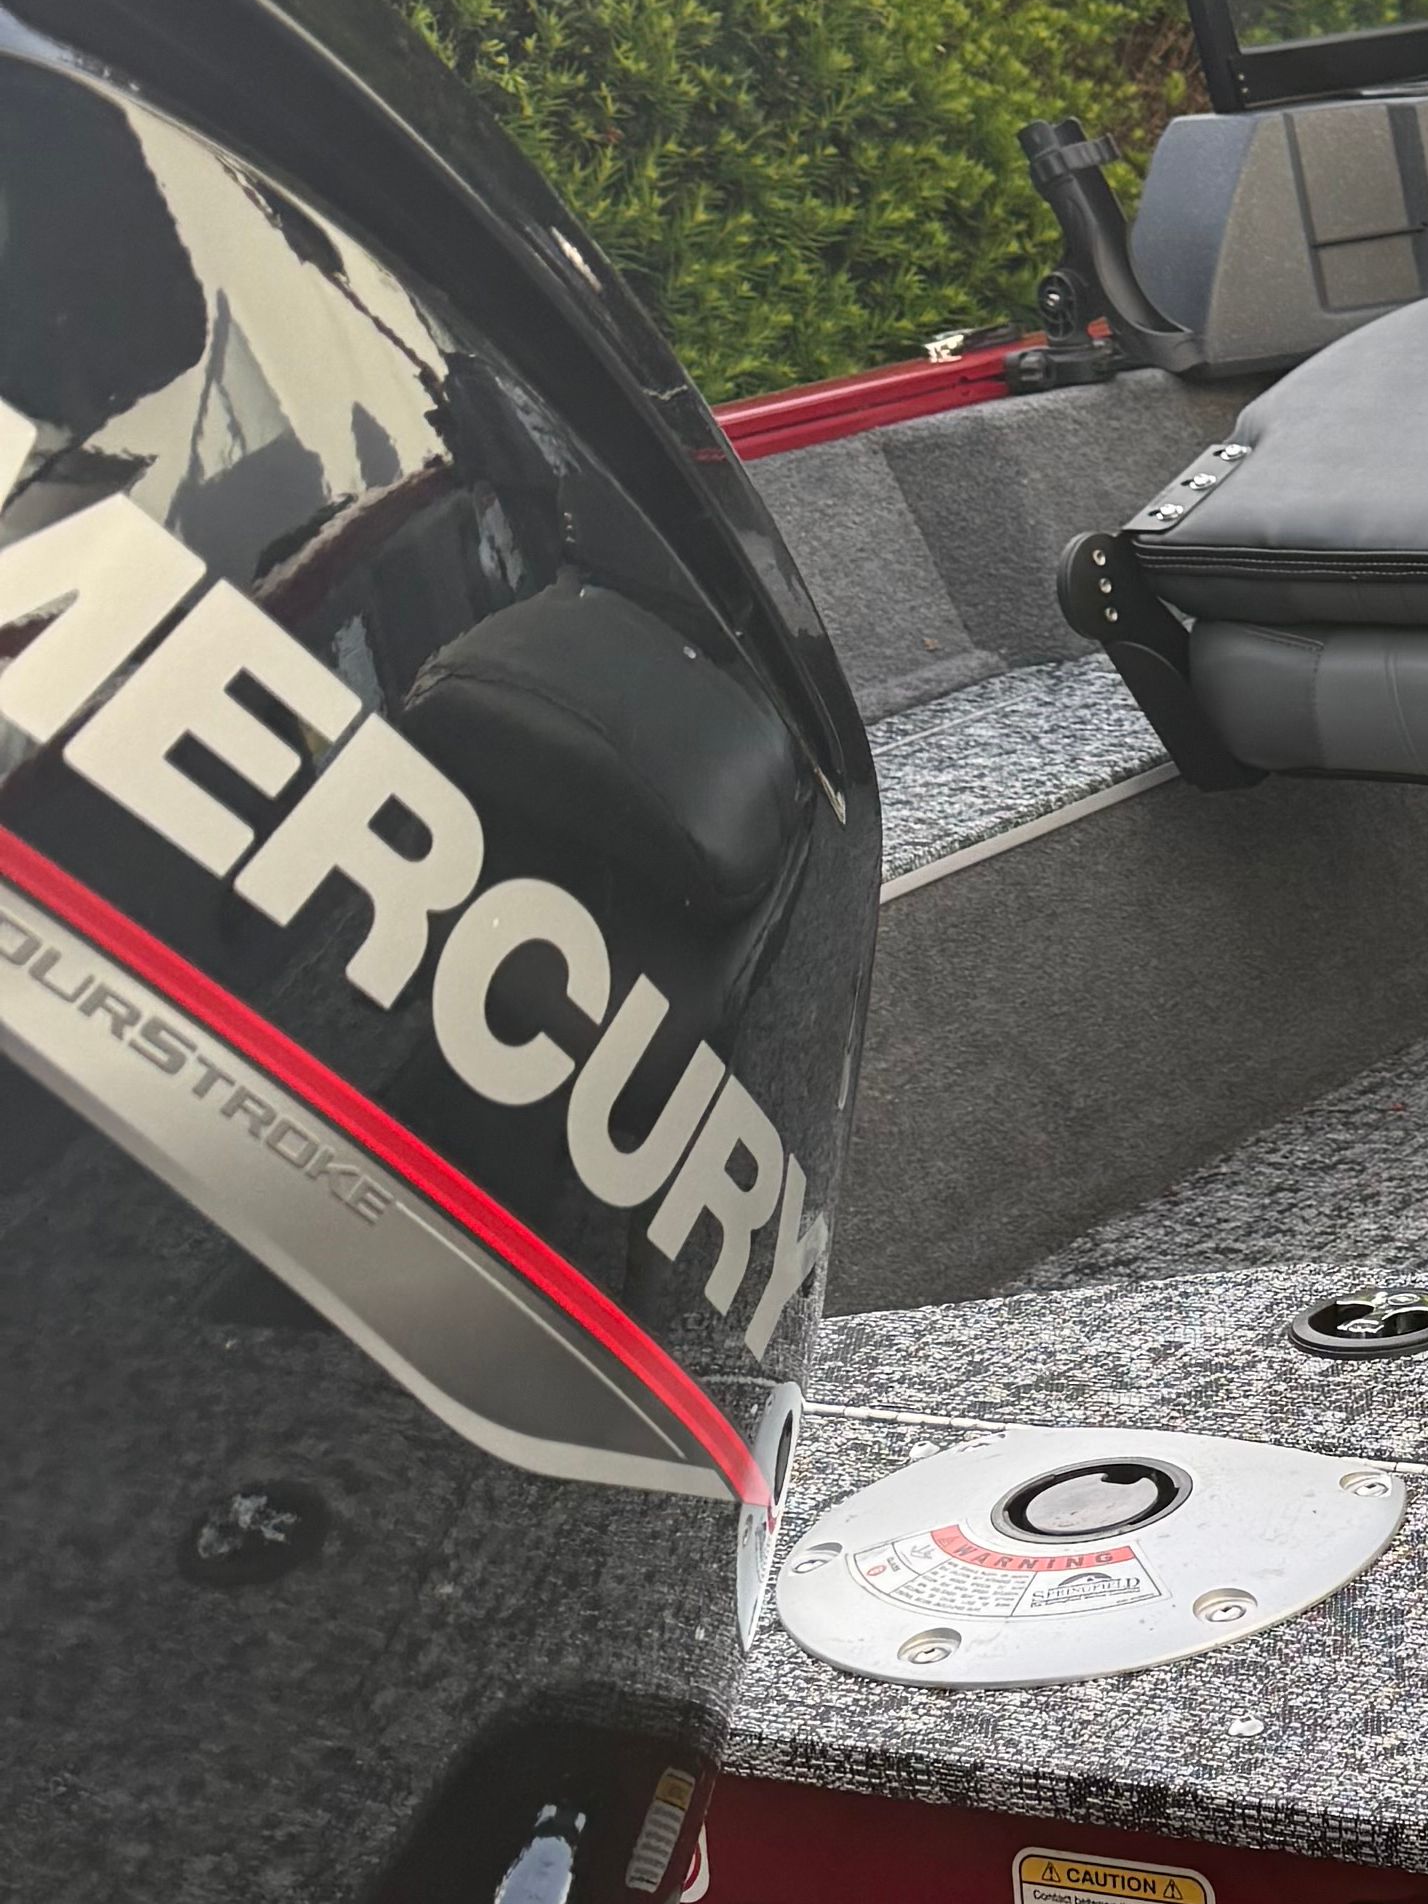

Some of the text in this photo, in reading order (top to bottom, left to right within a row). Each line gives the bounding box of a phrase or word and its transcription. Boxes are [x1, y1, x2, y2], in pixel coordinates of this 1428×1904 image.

[954, 1543, 1114, 1570] WARNING
[1066, 1868, 1156, 1894] CAUTION
[1034, 1890, 1072, 1904] Contact
